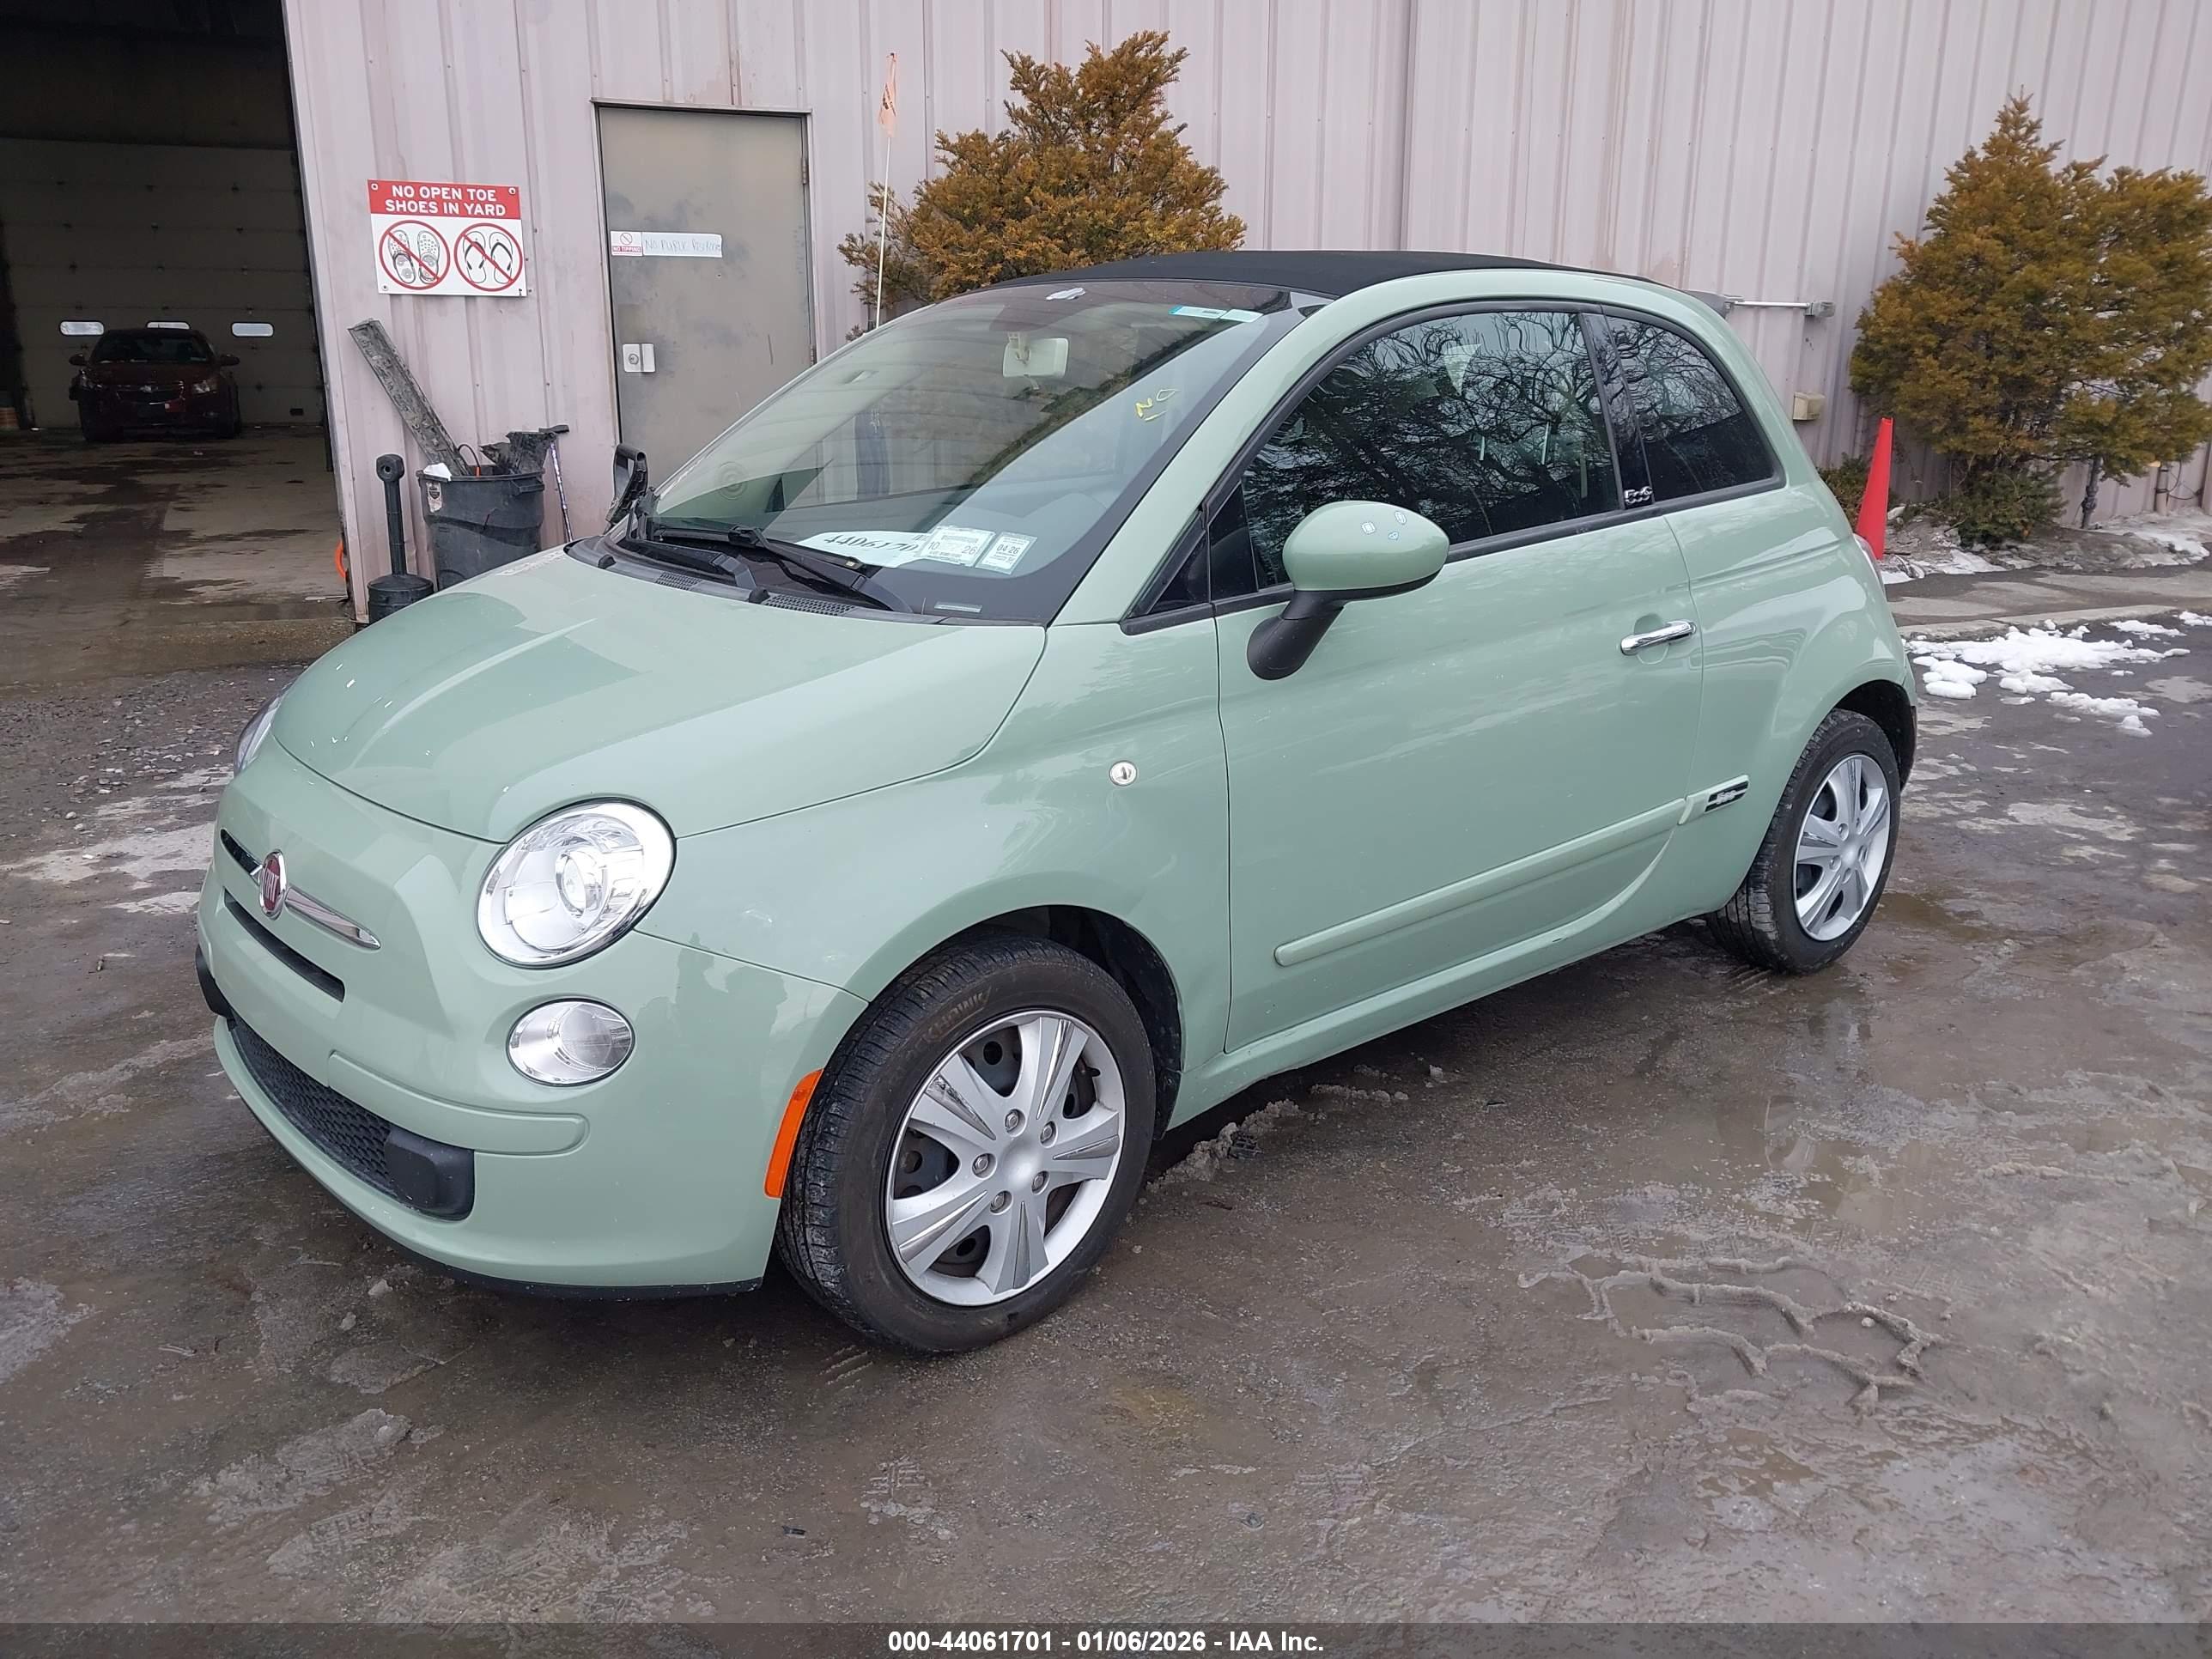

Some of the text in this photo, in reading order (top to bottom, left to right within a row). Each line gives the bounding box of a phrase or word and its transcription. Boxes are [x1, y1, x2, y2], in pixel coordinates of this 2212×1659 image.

[392, 185, 497, 202] NO OPEN TOE
[385, 199, 506, 216] SHOES IN YARD
[927, 541, 940, 550] 10
[961, 545, 977, 556] 26
[1008, 546, 1021, 555] 26
